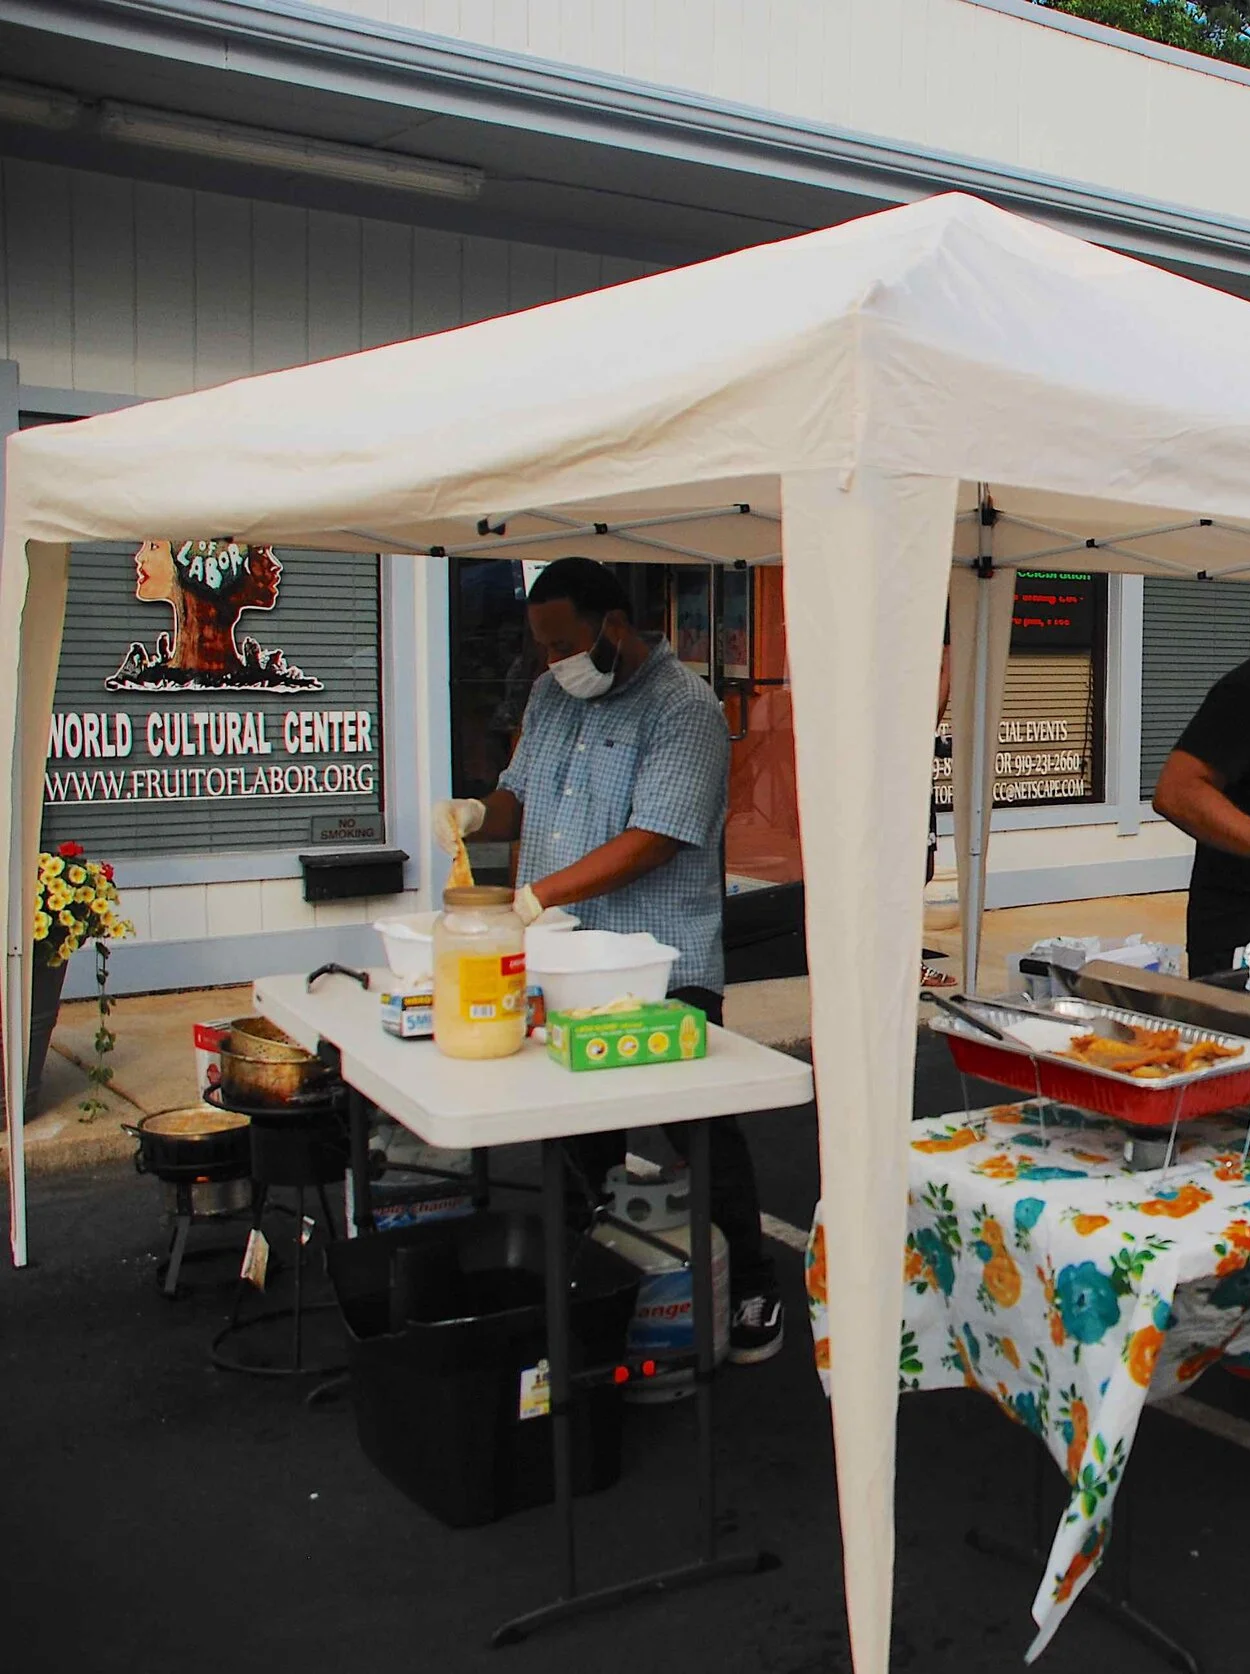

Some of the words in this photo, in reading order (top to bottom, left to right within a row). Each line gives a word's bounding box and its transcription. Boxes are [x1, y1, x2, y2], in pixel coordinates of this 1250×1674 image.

[199, 540, 217, 556] OF
[177, 540, 243, 589] LABOR
[147, 711, 272, 757] CULTURAL
[284, 710, 373, 754] CENTER
[1026, 720, 1068, 742] EVENTS
[995, 752, 1012, 775] OR
[44, 763, 374, 801] WWW.FRUITOFLABOR.ORG
[320, 827, 375, 840] SMOKING
[338, 818, 356, 829] NO
